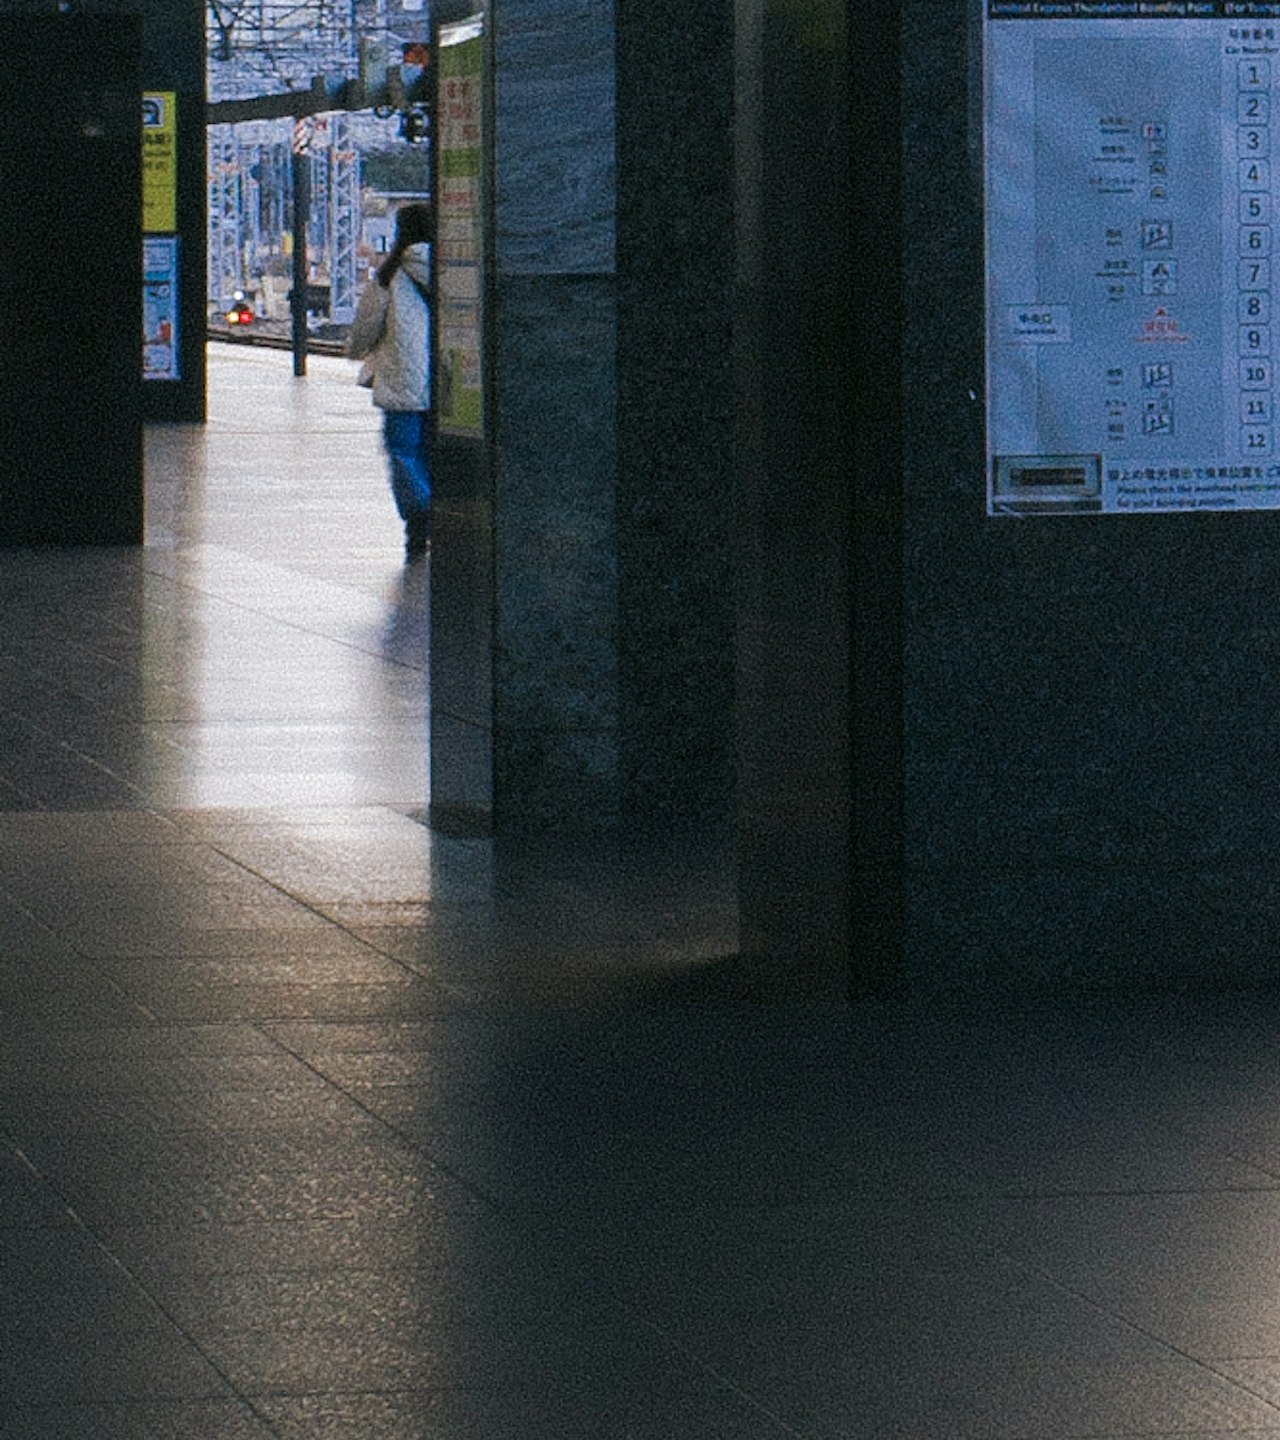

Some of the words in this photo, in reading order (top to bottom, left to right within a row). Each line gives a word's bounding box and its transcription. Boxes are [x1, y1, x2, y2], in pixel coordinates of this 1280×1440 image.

[1248, 66, 1260, 84] 1
[1246, 98, 1259, 118] 2
[1246, 131, 1260, 150] 3
[1246, 165, 1260, 183] 4
[1249, 198, 1261, 217] 5
[1249, 230, 1262, 249] 6
[1249, 264, 1260, 283] 7
[1248, 297, 1260, 316] 8
[1248, 330, 1260, 349] 9
[1246, 367, 1266, 382] 10
[1247, 400, 1264, 415] 11
[1248, 433, 1266, 448] 12
